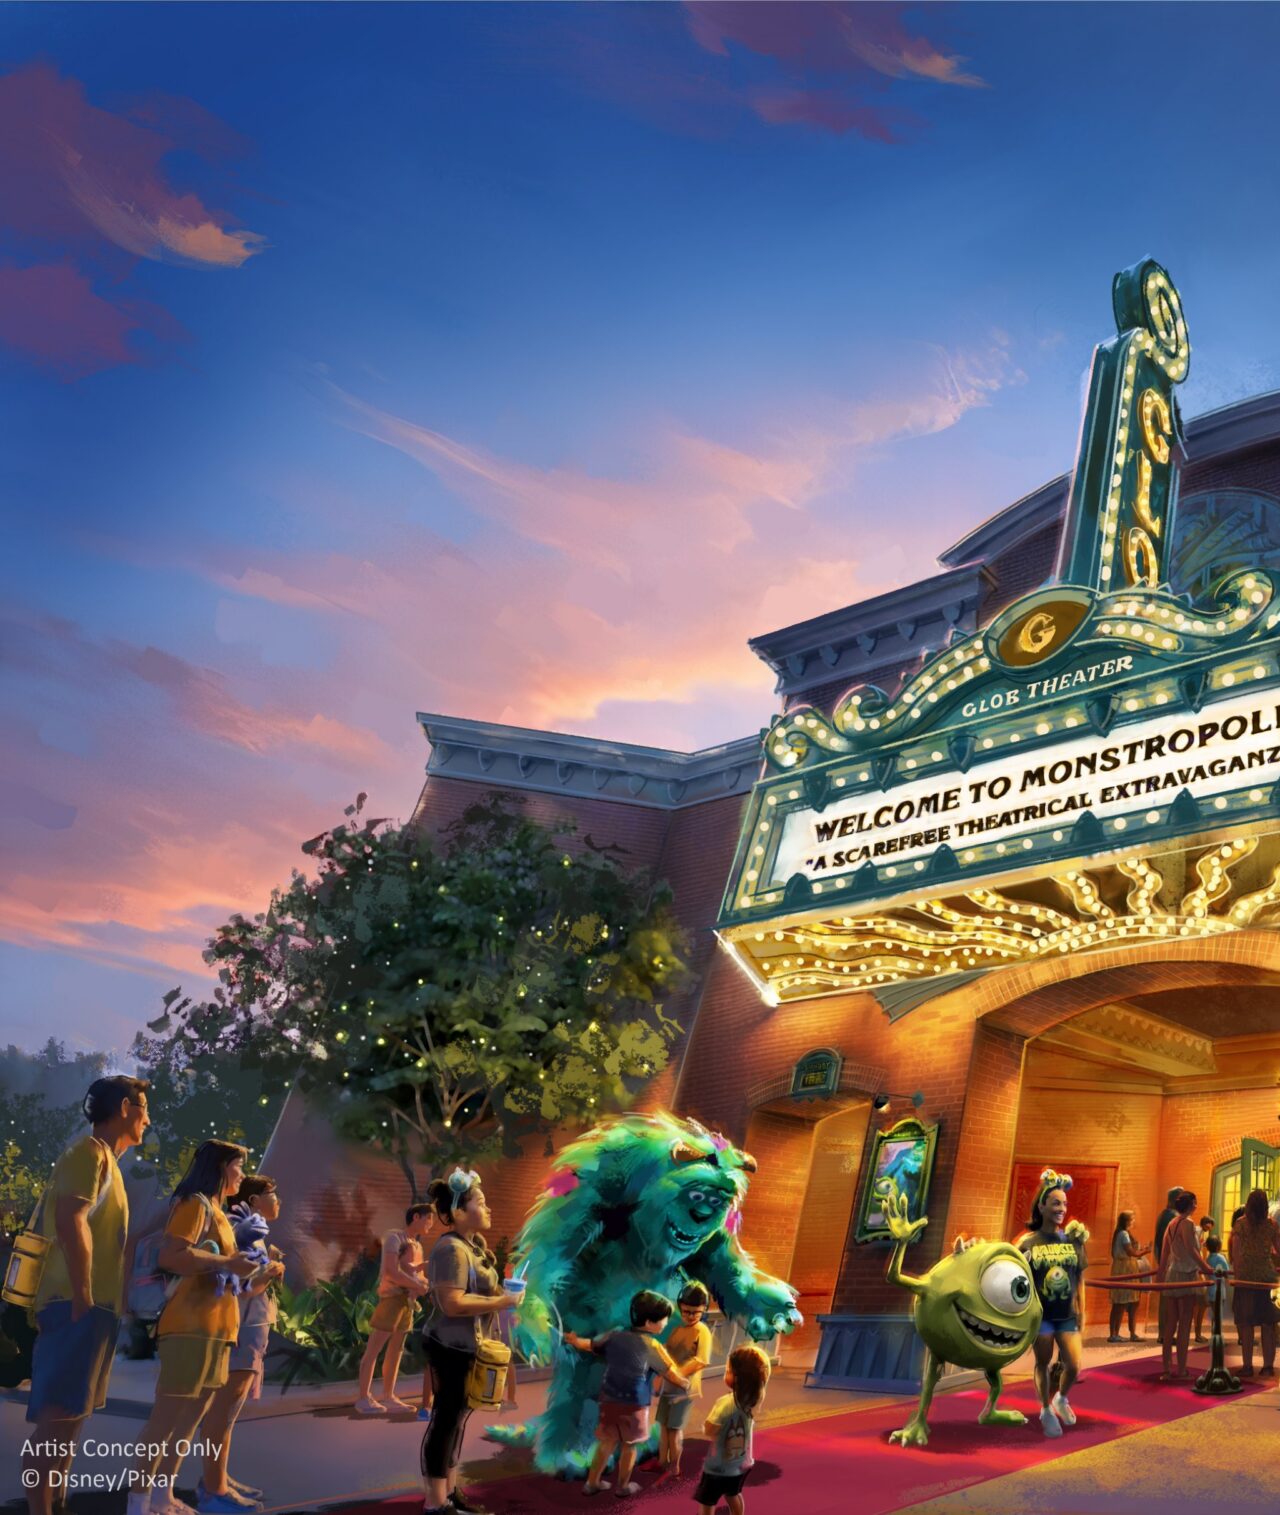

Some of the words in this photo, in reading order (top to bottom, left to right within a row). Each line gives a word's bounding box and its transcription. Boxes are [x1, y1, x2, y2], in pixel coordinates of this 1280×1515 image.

[1018, 612, 1056, 653] G
[961, 688, 1020, 718] GLOB
[1026, 655, 1134, 699] THEATER
[814, 788, 962, 843] WELCOME
[968, 776, 1012, 804] TO
[832, 825, 951, 868] SCAREFREE
[954, 792, 1093, 838] THEATRICAL
